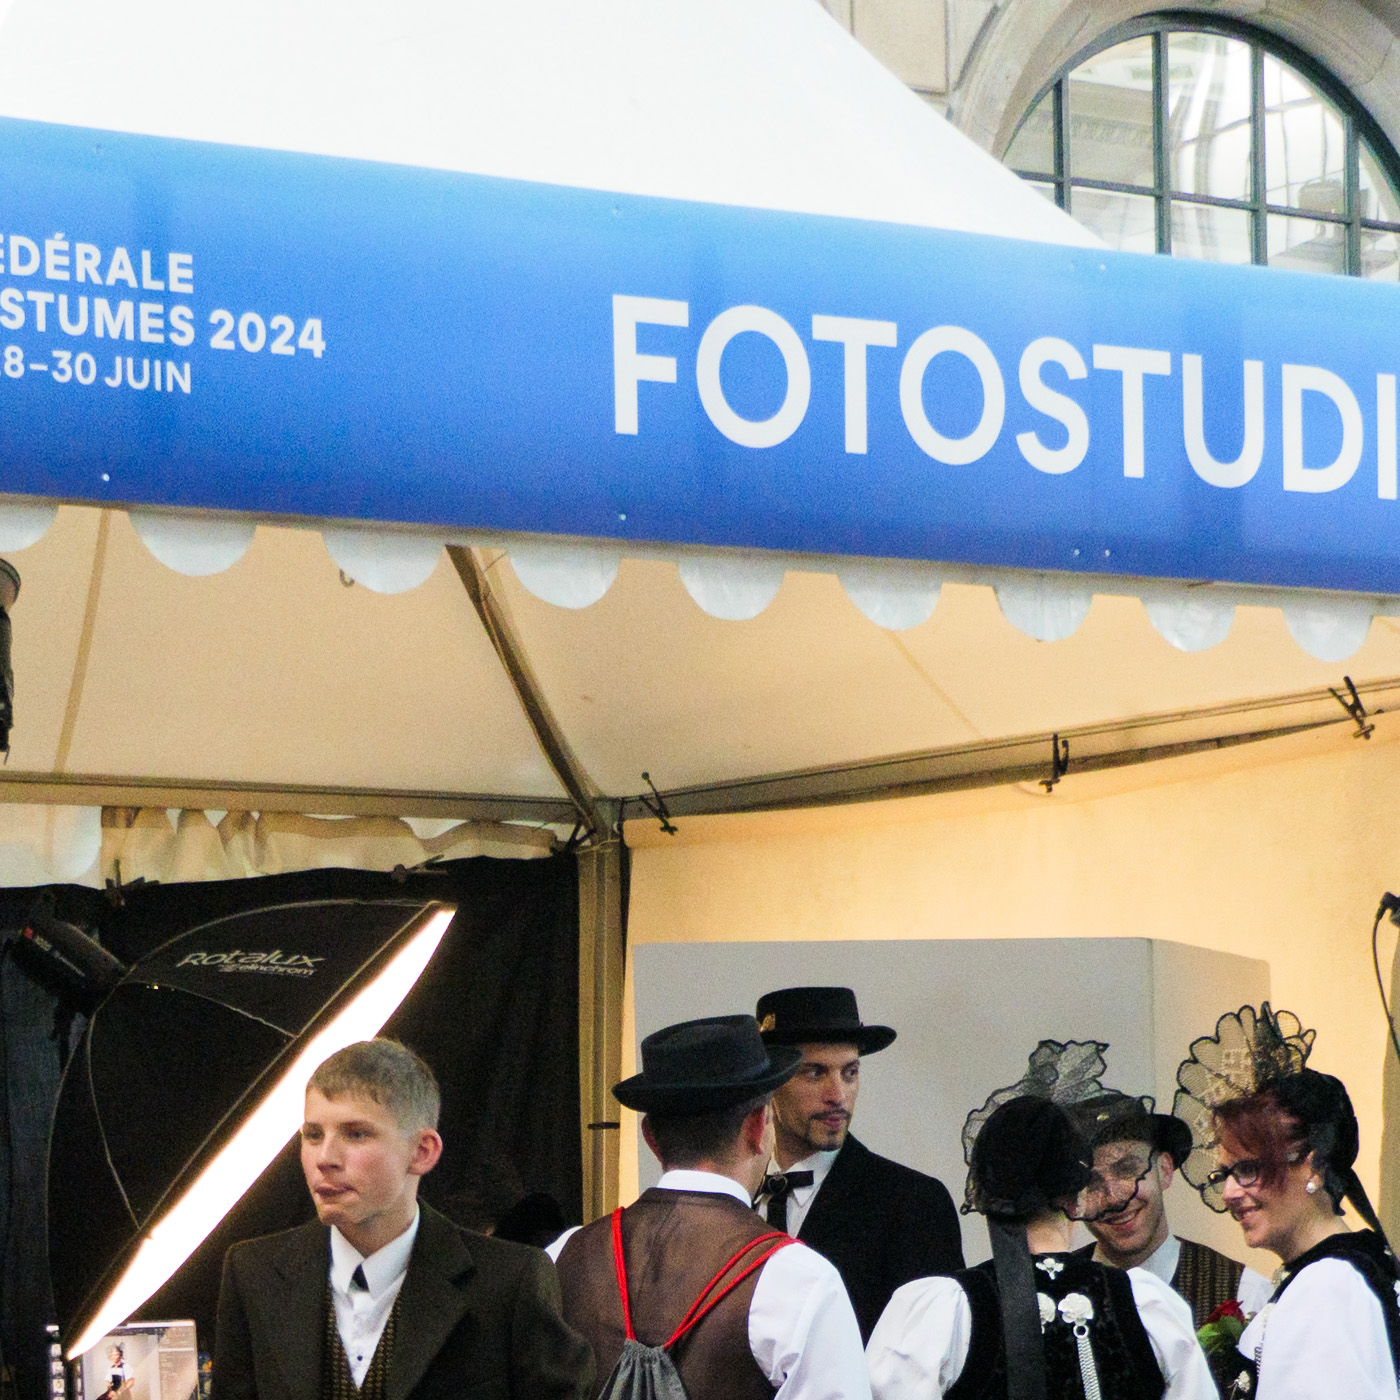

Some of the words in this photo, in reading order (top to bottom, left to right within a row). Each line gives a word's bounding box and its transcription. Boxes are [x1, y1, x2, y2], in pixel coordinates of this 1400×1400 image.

[208, 308, 327, 359] 2024
[104, 355, 192, 395] JUIN
[175, 949, 326, 968] Rotalux
